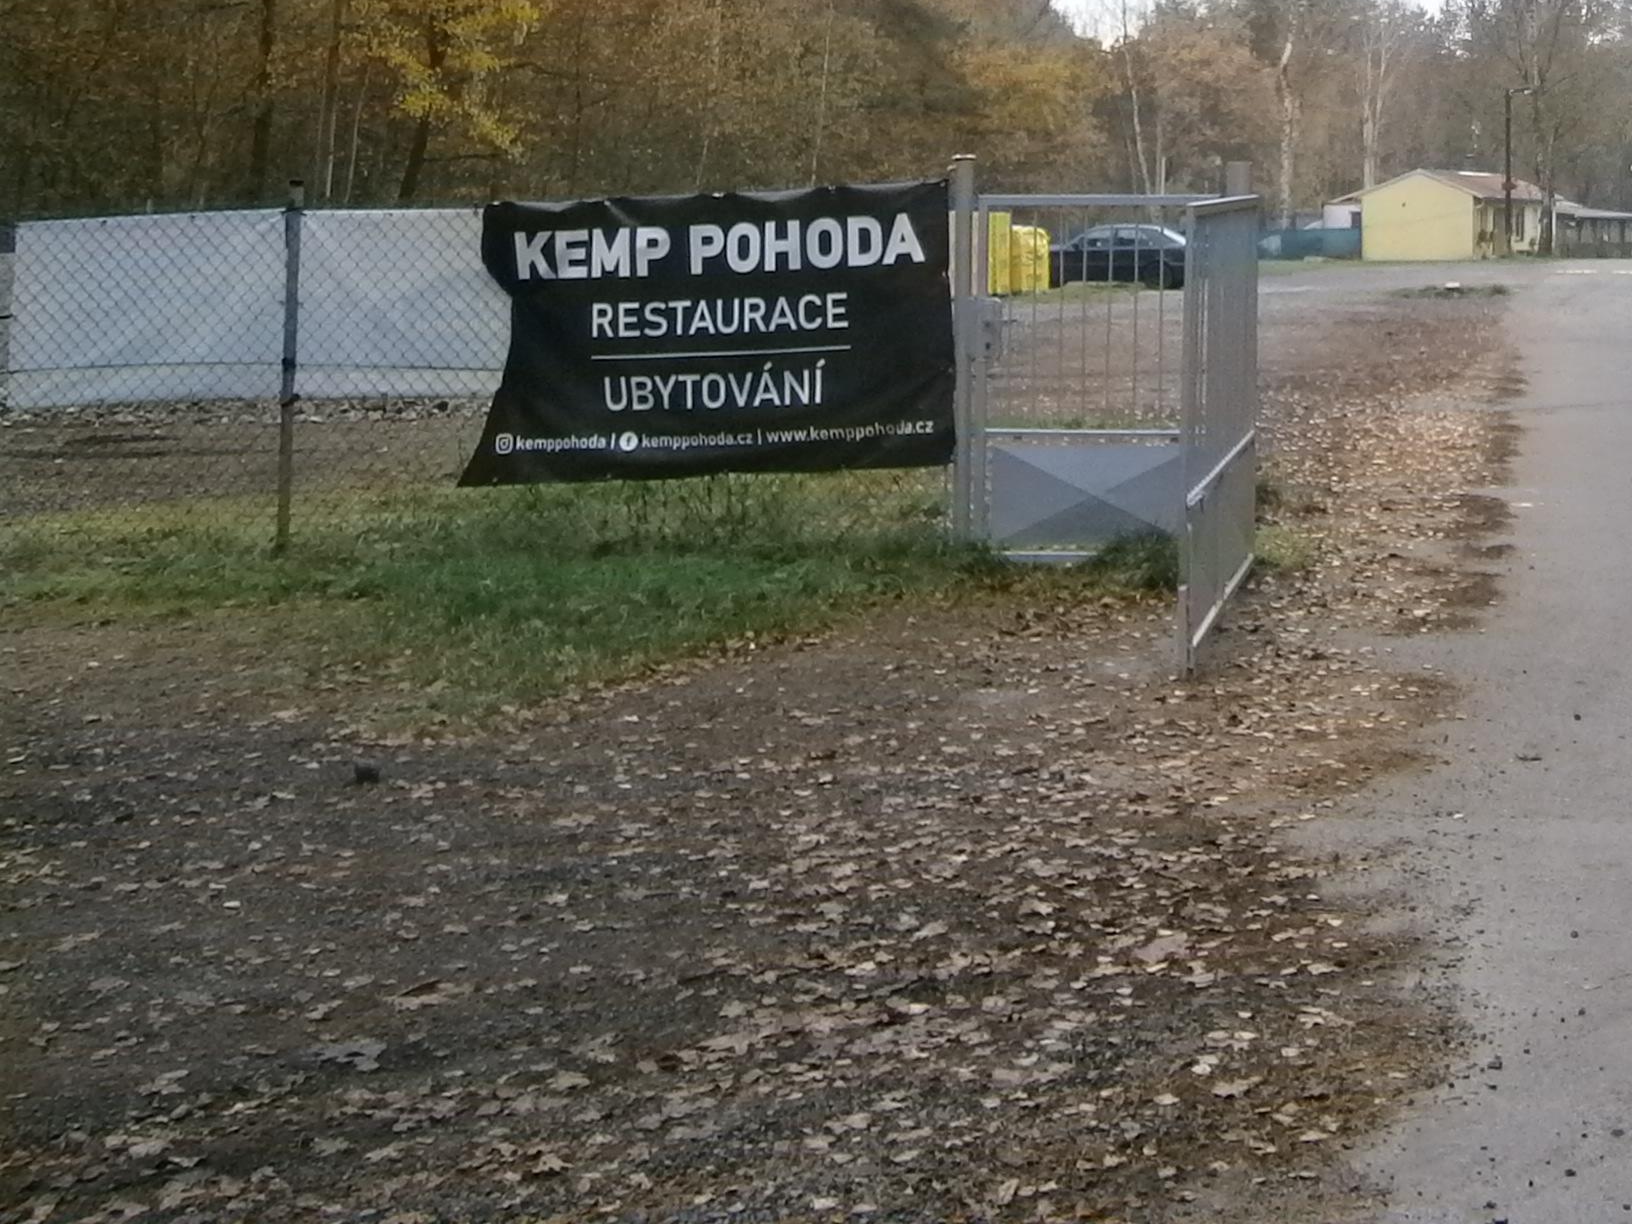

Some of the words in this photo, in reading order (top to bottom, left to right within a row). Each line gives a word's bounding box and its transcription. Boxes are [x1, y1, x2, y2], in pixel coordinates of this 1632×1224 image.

[514, 226, 671, 280] KEMP
[689, 212, 926, 275] POHODA
[591, 292, 849, 338] RESTAURACE
[604, 358, 826, 412] UBYTOVÁNÍ
[515, 433, 607, 452] kemppohoda
[641, 431, 754, 450] kemppohoda.cz
[766, 420, 934, 444] www.kemppohoda.cz
